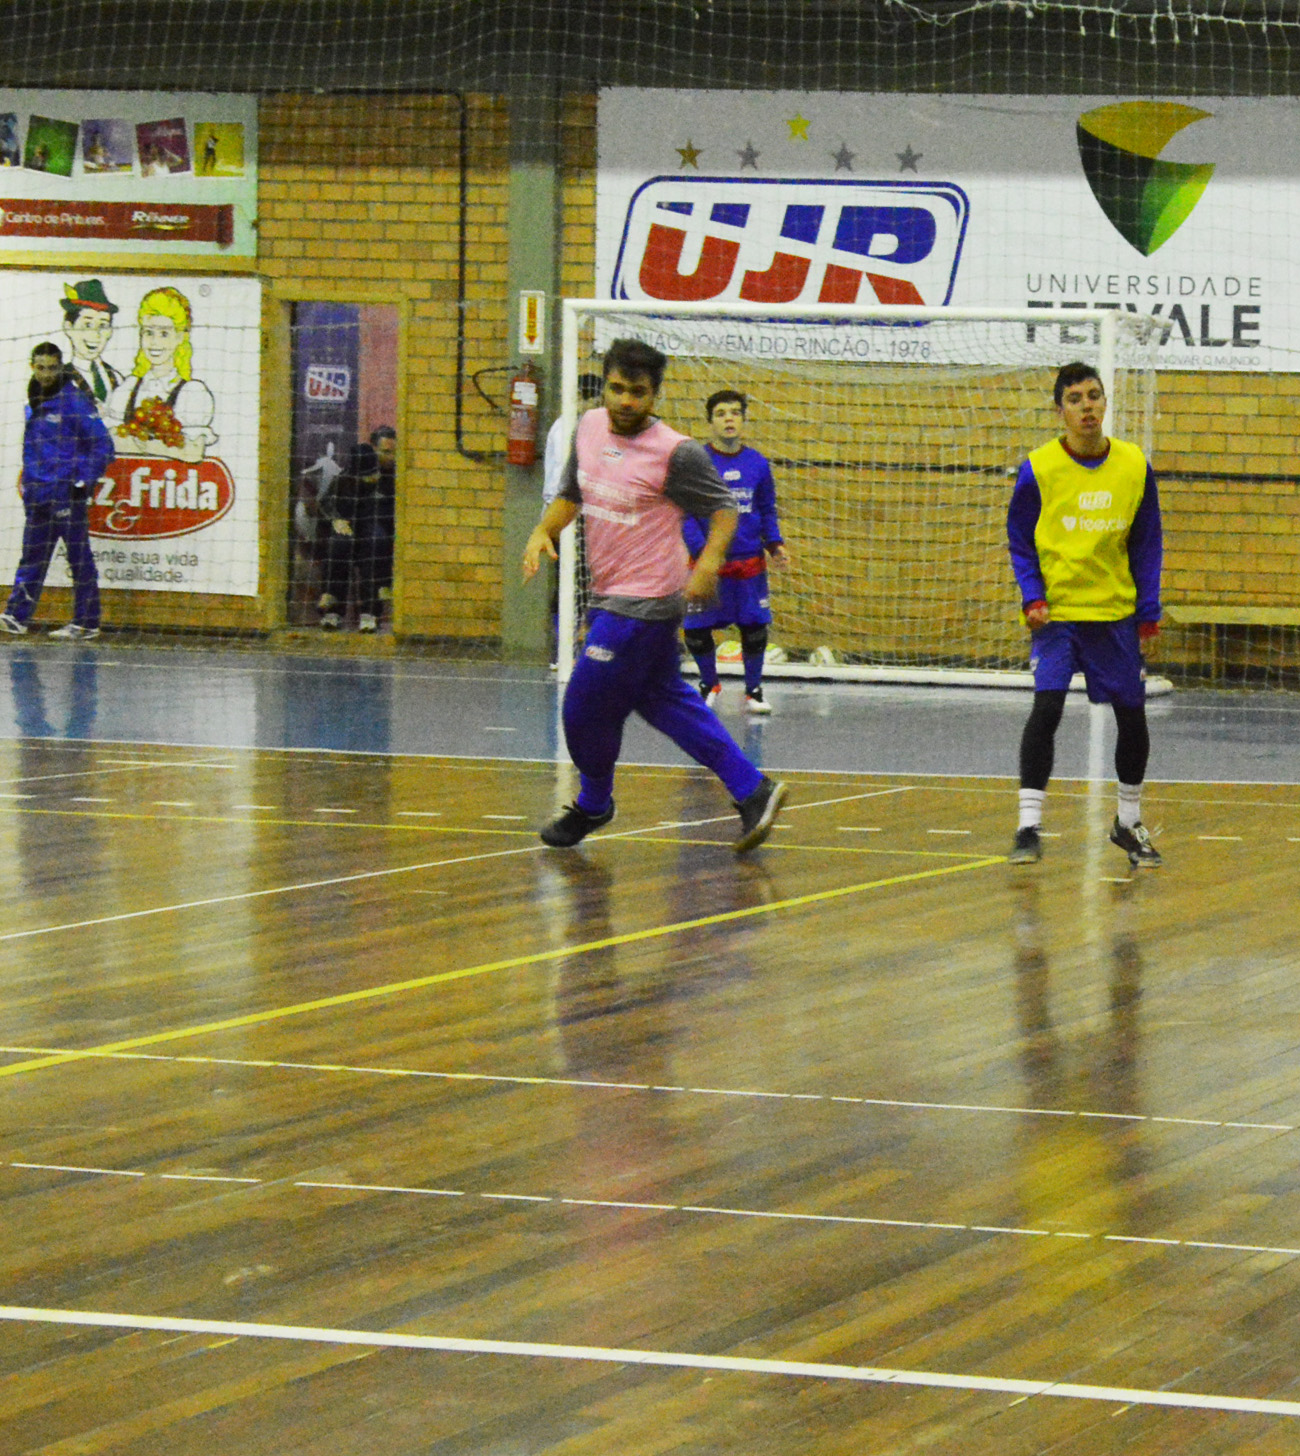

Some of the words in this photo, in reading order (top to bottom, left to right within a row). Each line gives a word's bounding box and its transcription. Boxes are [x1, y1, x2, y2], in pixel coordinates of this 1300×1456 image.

[5, 211, 42, 224] Centro
[44, 212, 59, 225] de
[639, 200, 937, 306] UJR
[1027, 273, 1262, 297] UNIVERSIDADE
[760, 336, 787, 354] DO
[890, 339, 931, 359] 1978
[131, 552, 160, 565] sua
[165, 551, 199, 567] vida
